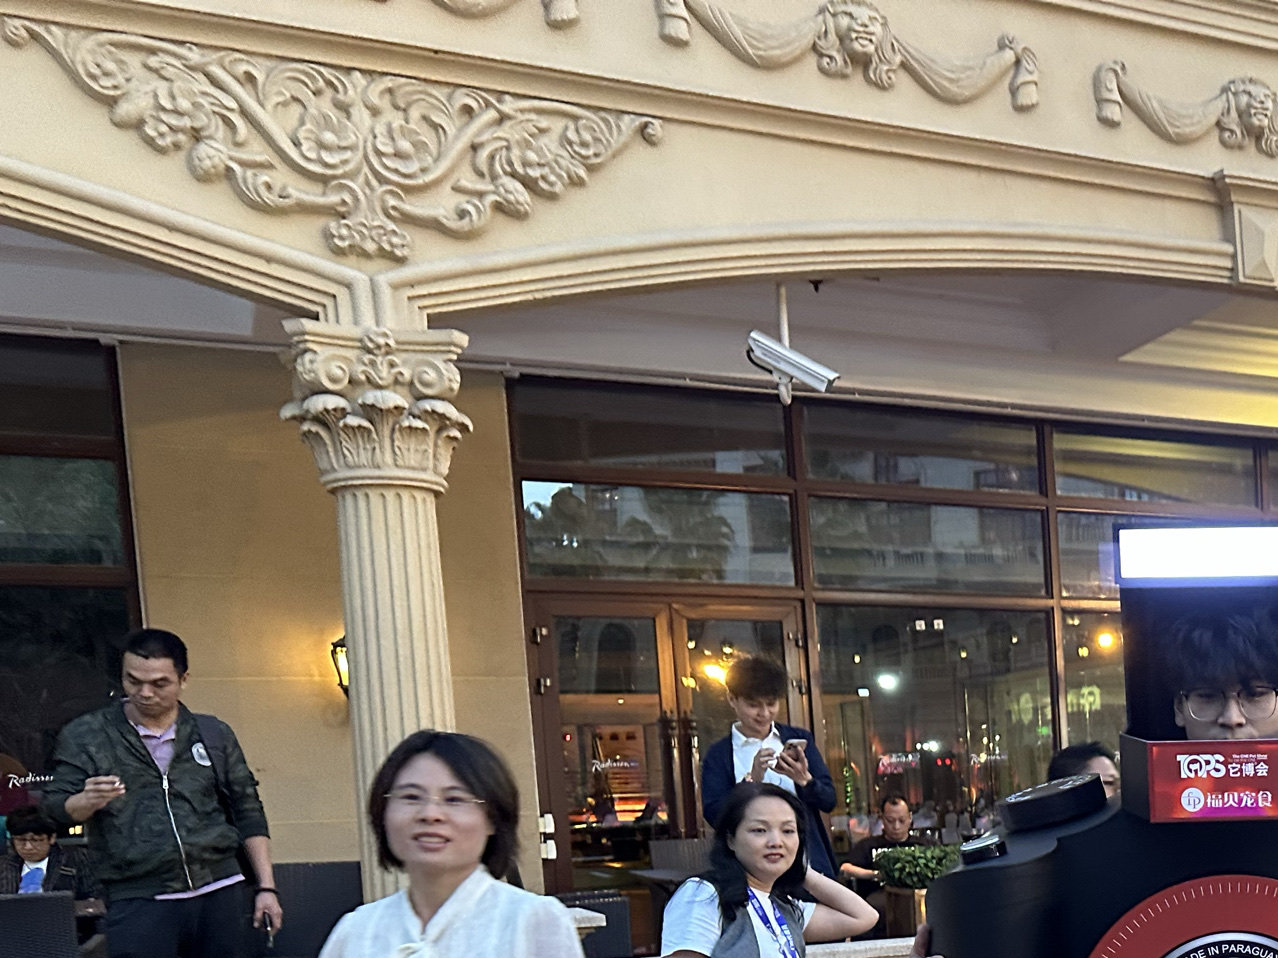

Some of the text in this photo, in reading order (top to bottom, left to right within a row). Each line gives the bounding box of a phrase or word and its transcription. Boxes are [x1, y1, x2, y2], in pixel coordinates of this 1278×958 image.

[1177, 754, 1269, 779] TOPS 它博会
[1206, 790, 1273, 808] 福贝宠食
[1207, 945, 1220, 956] IN
